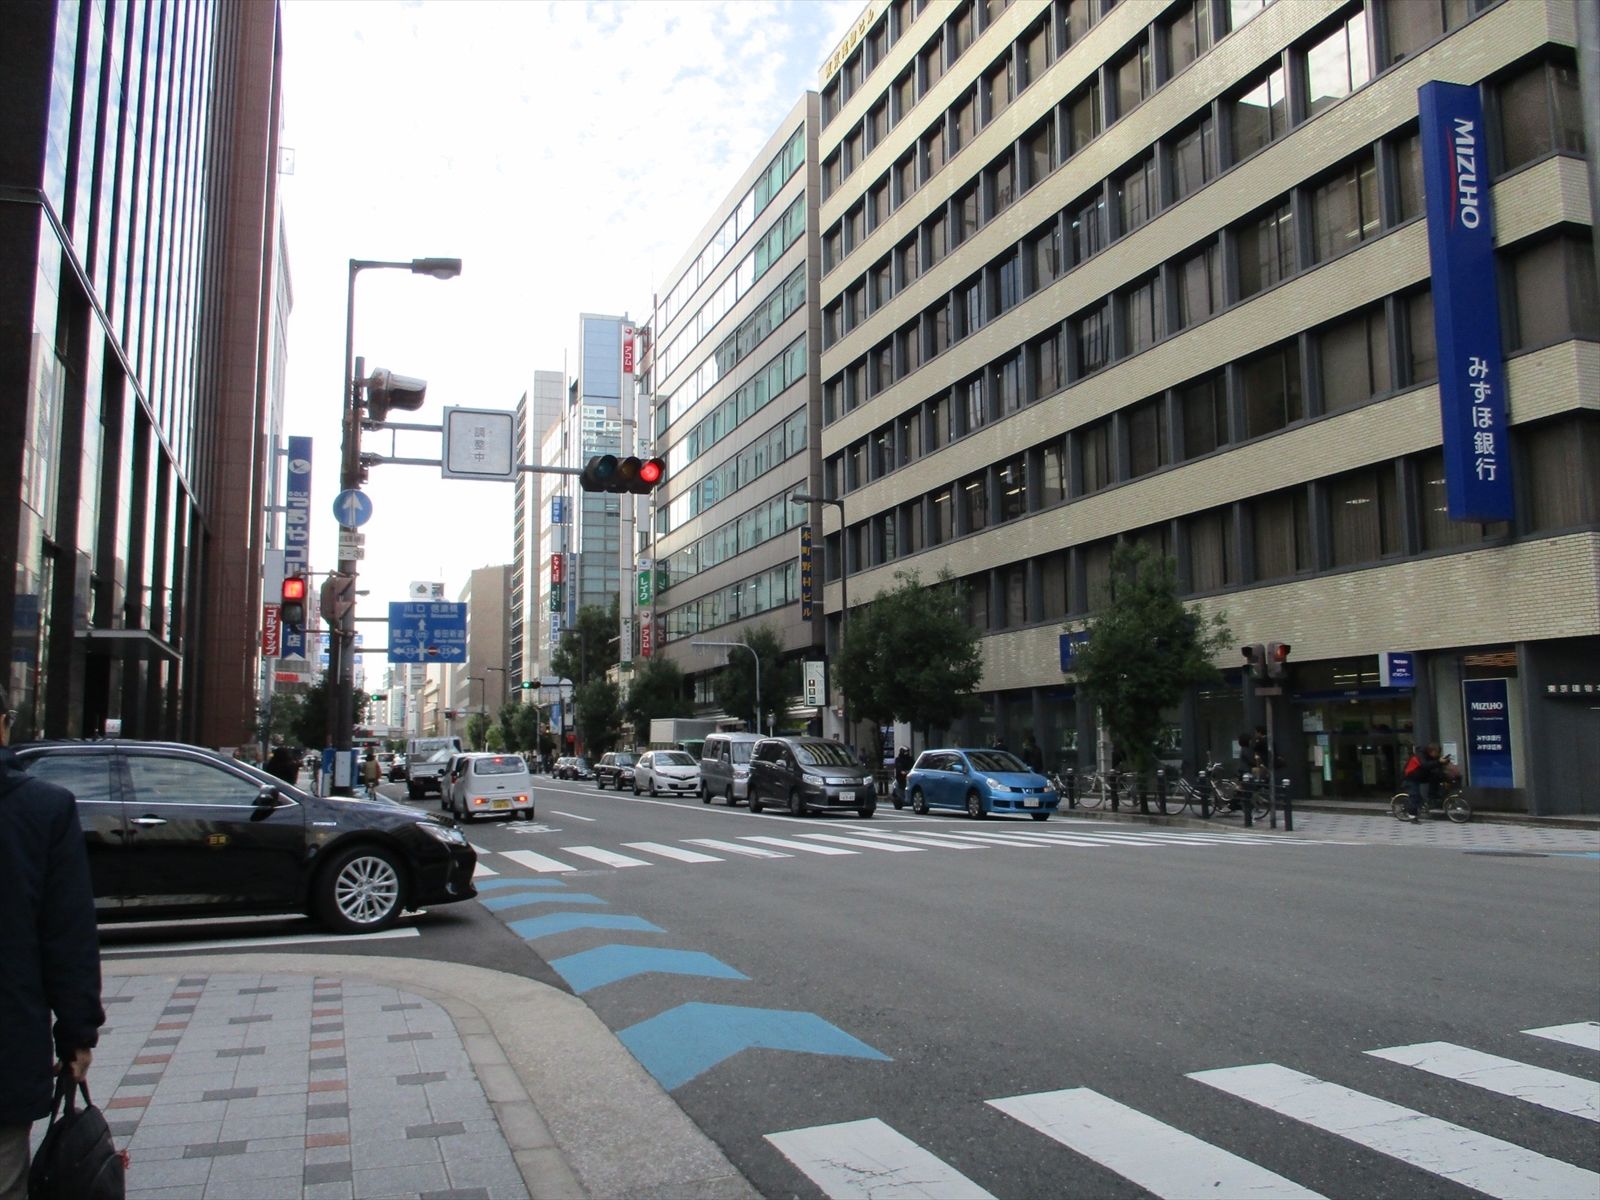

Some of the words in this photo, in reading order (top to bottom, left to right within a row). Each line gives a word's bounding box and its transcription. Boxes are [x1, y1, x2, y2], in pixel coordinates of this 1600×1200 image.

[1454, 118, 1480, 229] MIZUHO
[474, 426, 486, 463] 調整中
[1468, 356, 1497, 481] みずほ銀行
[640, 577, 649, 600] レイク
[802, 531, 812, 617] 本町野村ビル
[1471, 702, 1503, 710] MIZUHO
